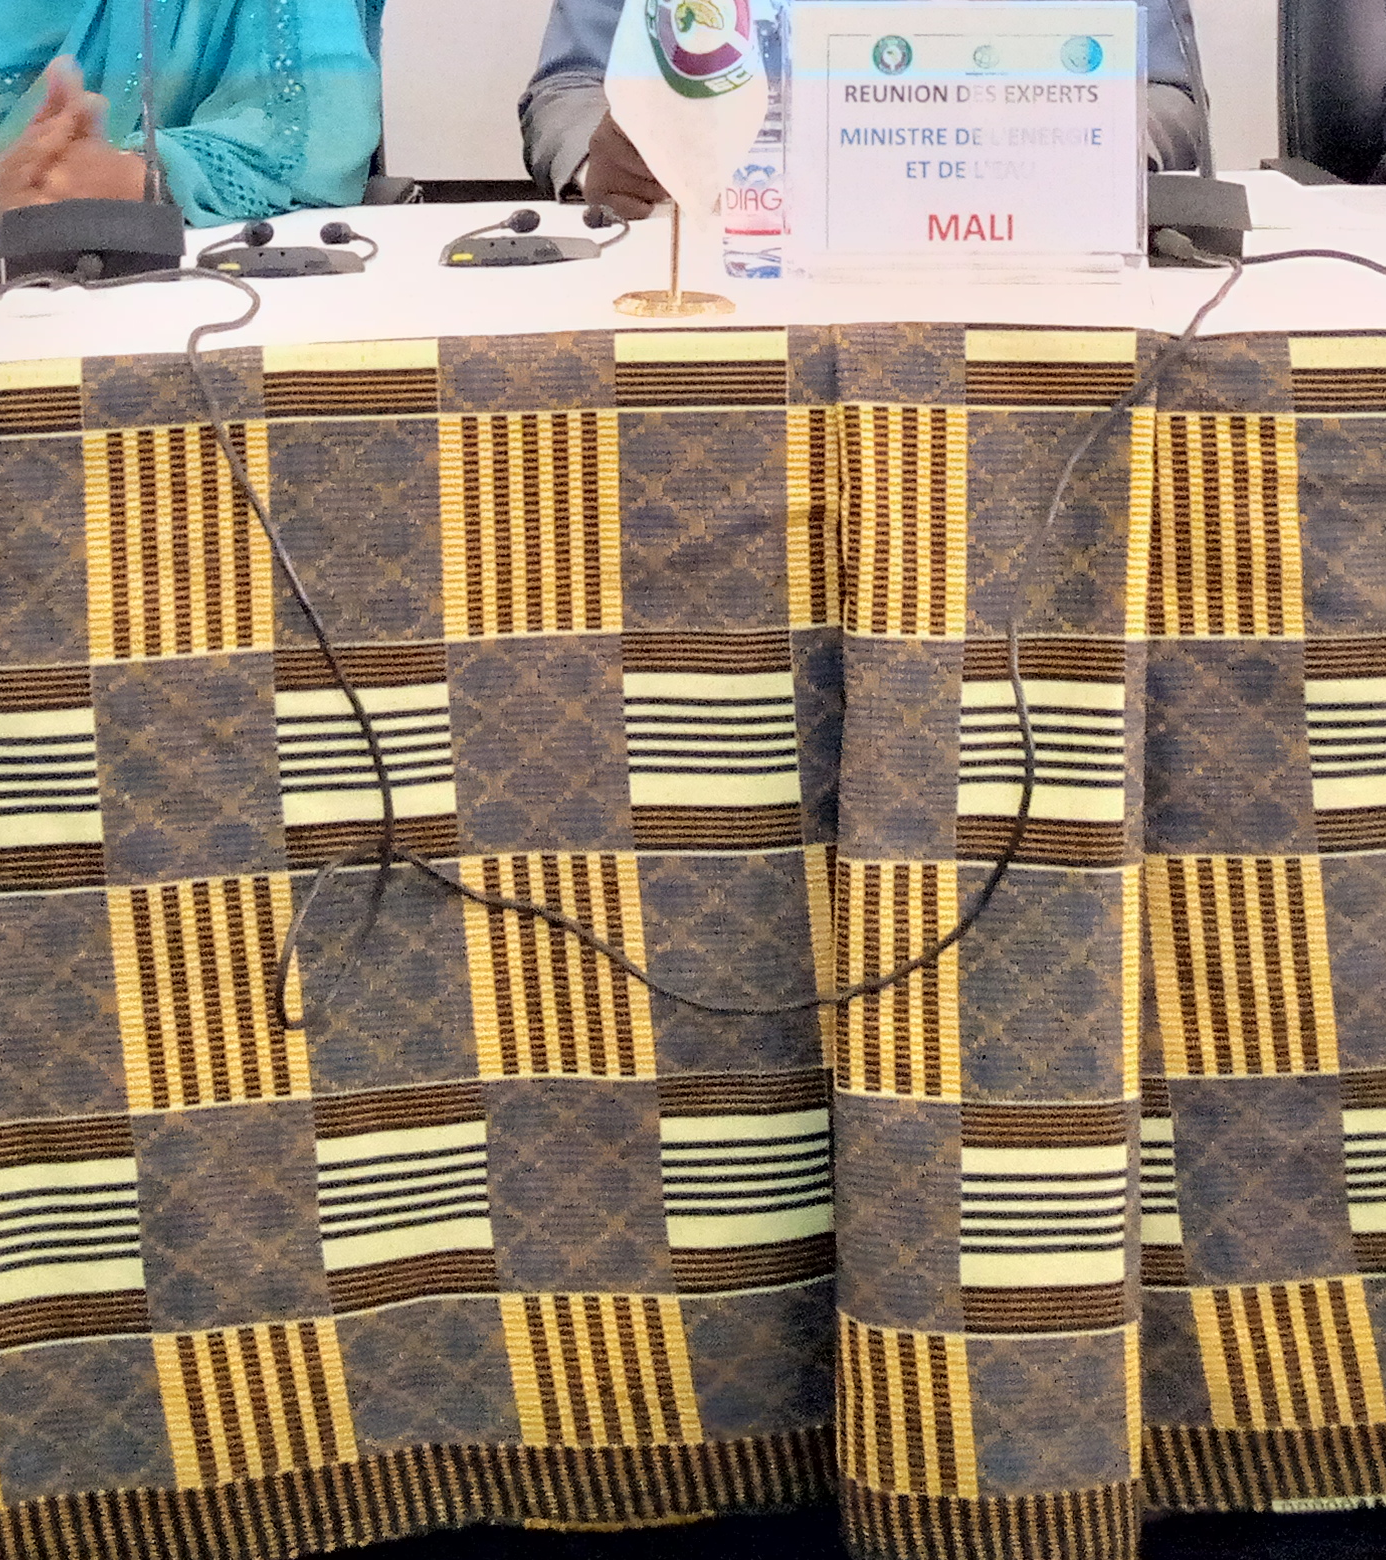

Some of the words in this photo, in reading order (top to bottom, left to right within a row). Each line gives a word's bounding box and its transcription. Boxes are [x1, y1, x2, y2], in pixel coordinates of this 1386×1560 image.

[844, 85, 948, 103] REUNION
[956, 85, 997, 103] DES
[1005, 85, 1099, 103] EXPERTS
[840, 128, 947, 147] MINISTRE
[955, 128, 982, 146] DE
[906, 161, 931, 179] ET
[938, 161, 966, 179] DE
[928, 214, 1014, 242] MALI
